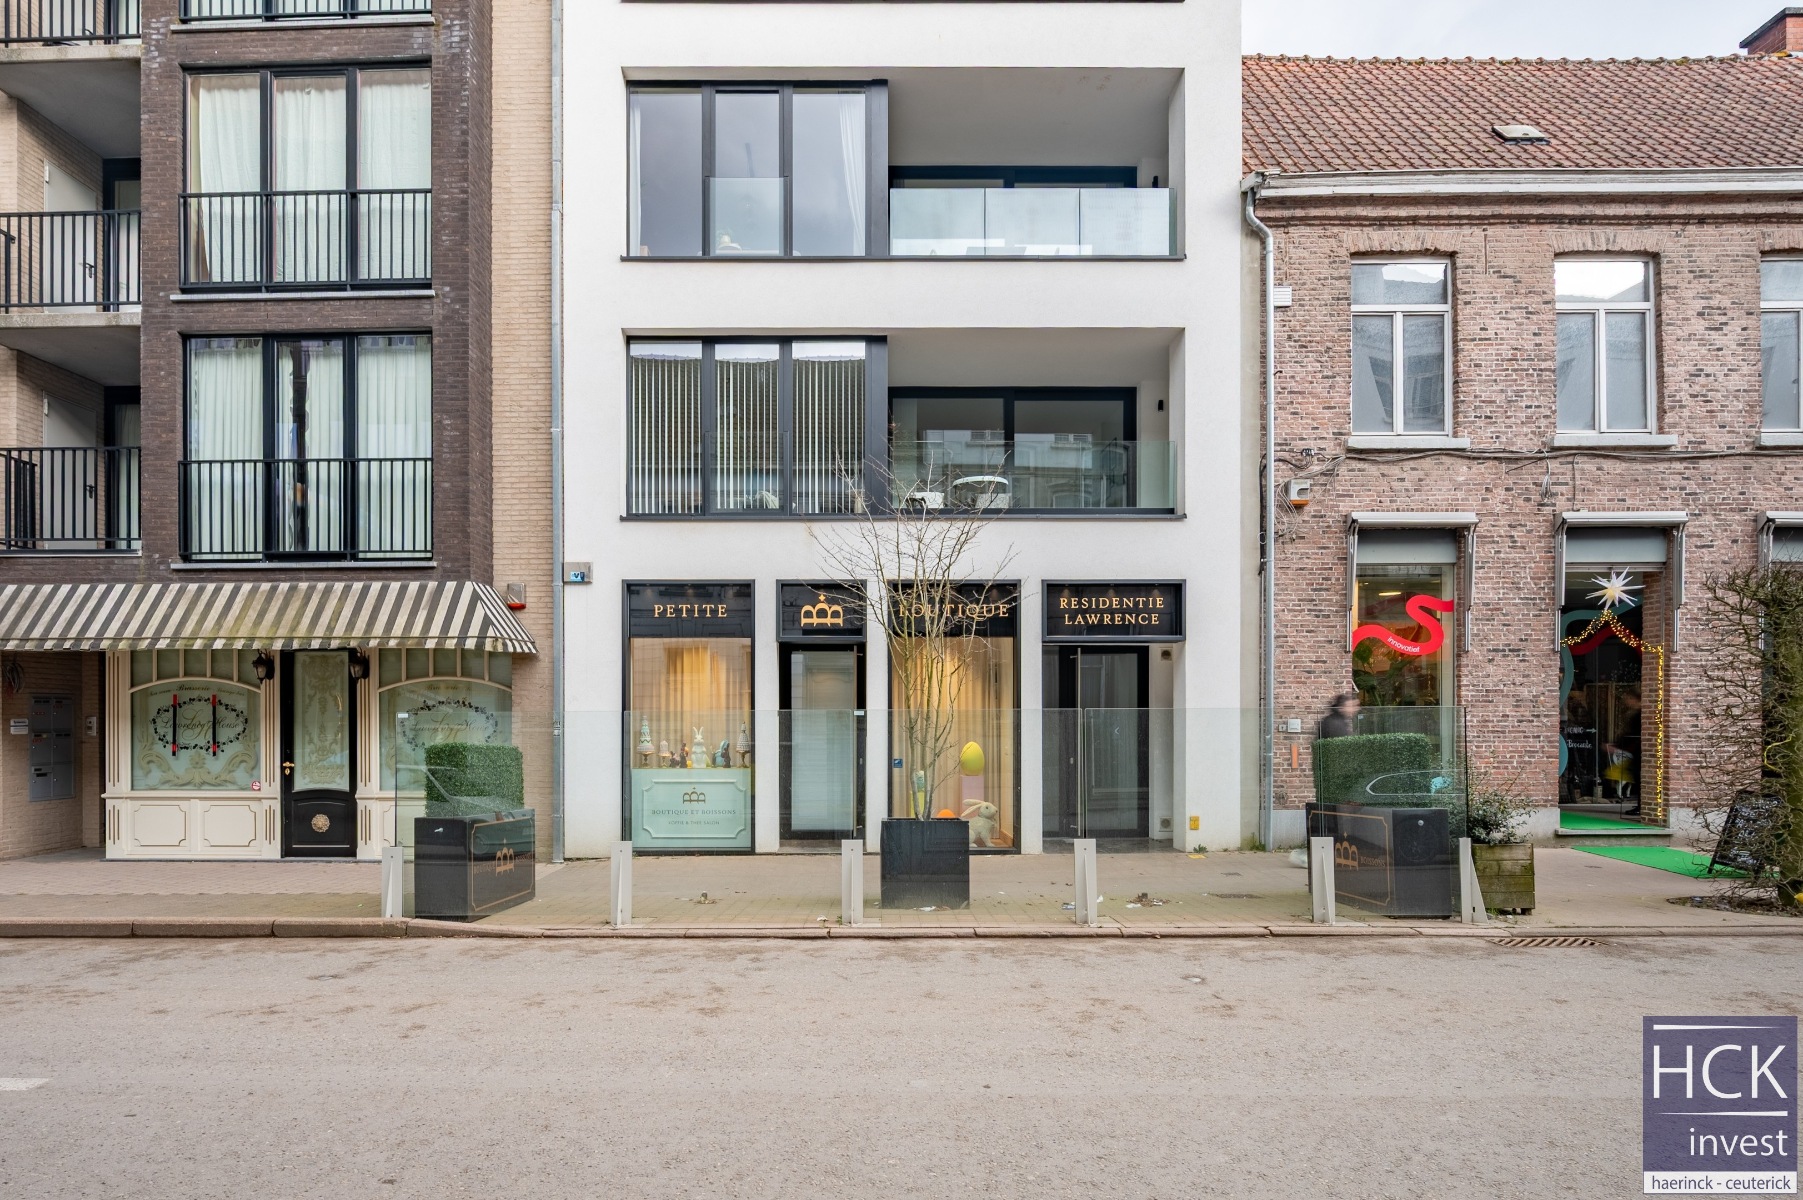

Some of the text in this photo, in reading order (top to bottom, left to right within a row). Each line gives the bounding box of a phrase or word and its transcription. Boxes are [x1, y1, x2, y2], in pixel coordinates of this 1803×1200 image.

[1059, 597, 1165, 609] RESIDENTIE
[653, 604, 728, 618] PETITE
[1064, 613, 1160, 625] LAWRENCE
[1387, 636, 1421, 653] innovatief
